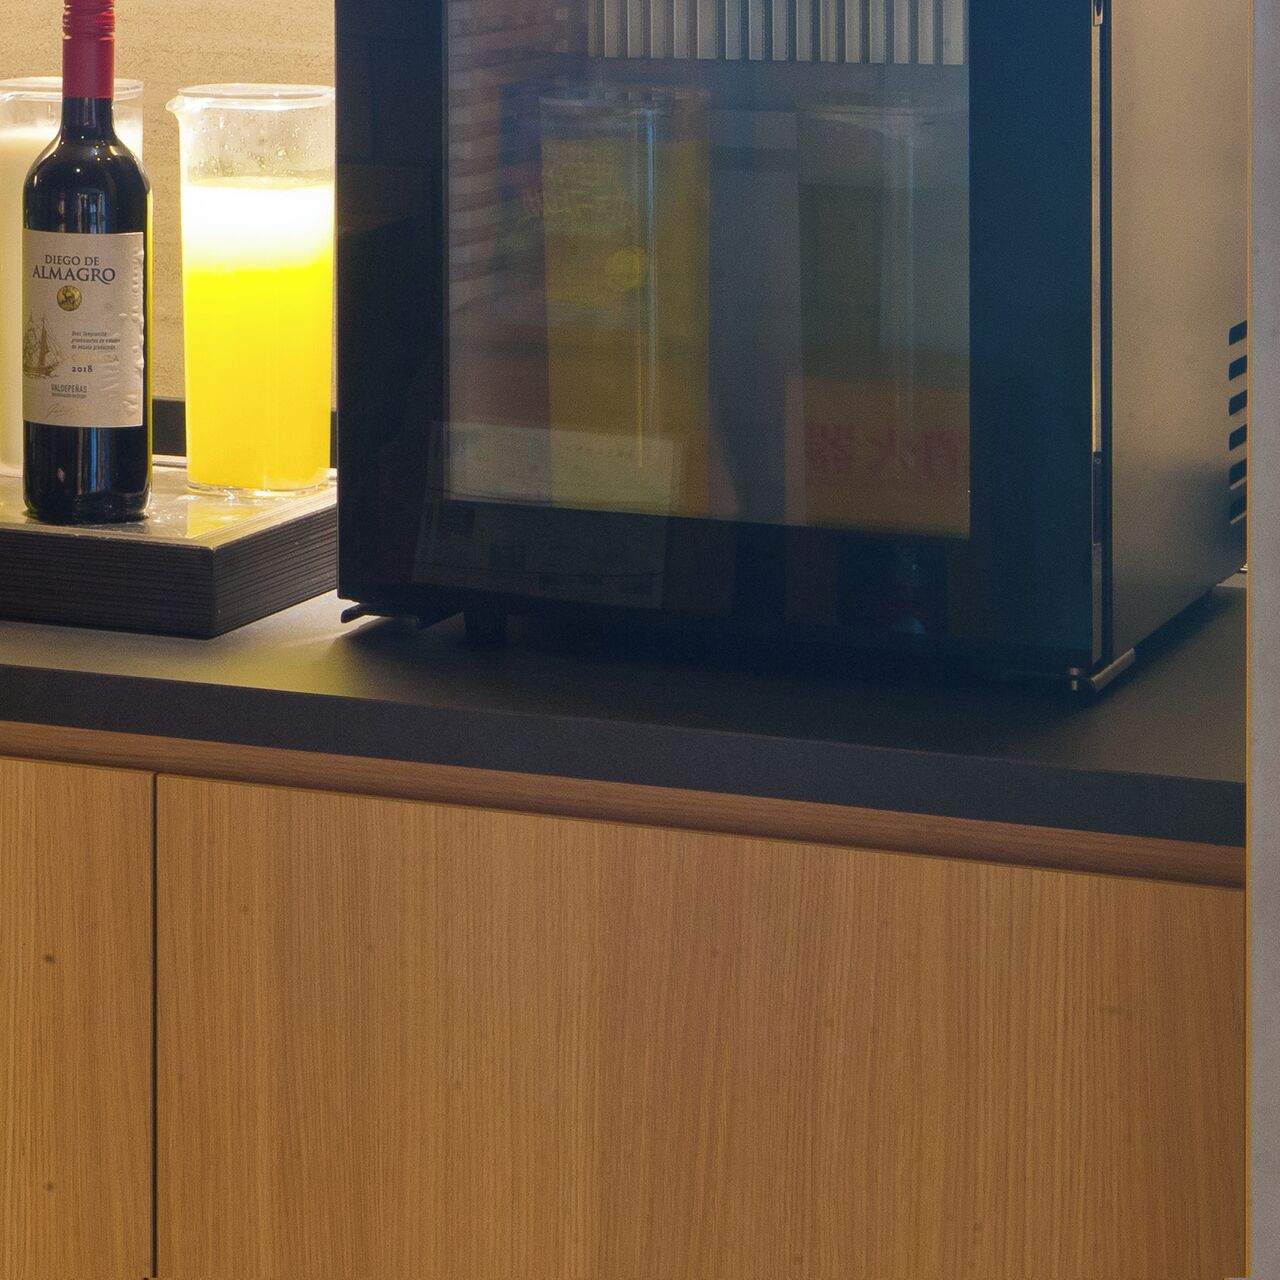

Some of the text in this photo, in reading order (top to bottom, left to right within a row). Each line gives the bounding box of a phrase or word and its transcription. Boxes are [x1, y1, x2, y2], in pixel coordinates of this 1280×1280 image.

[44, 254, 100, 266] DIEGO DE
[32, 265, 116, 285] ALMAGRO
[71, 365, 94, 373] 2018
